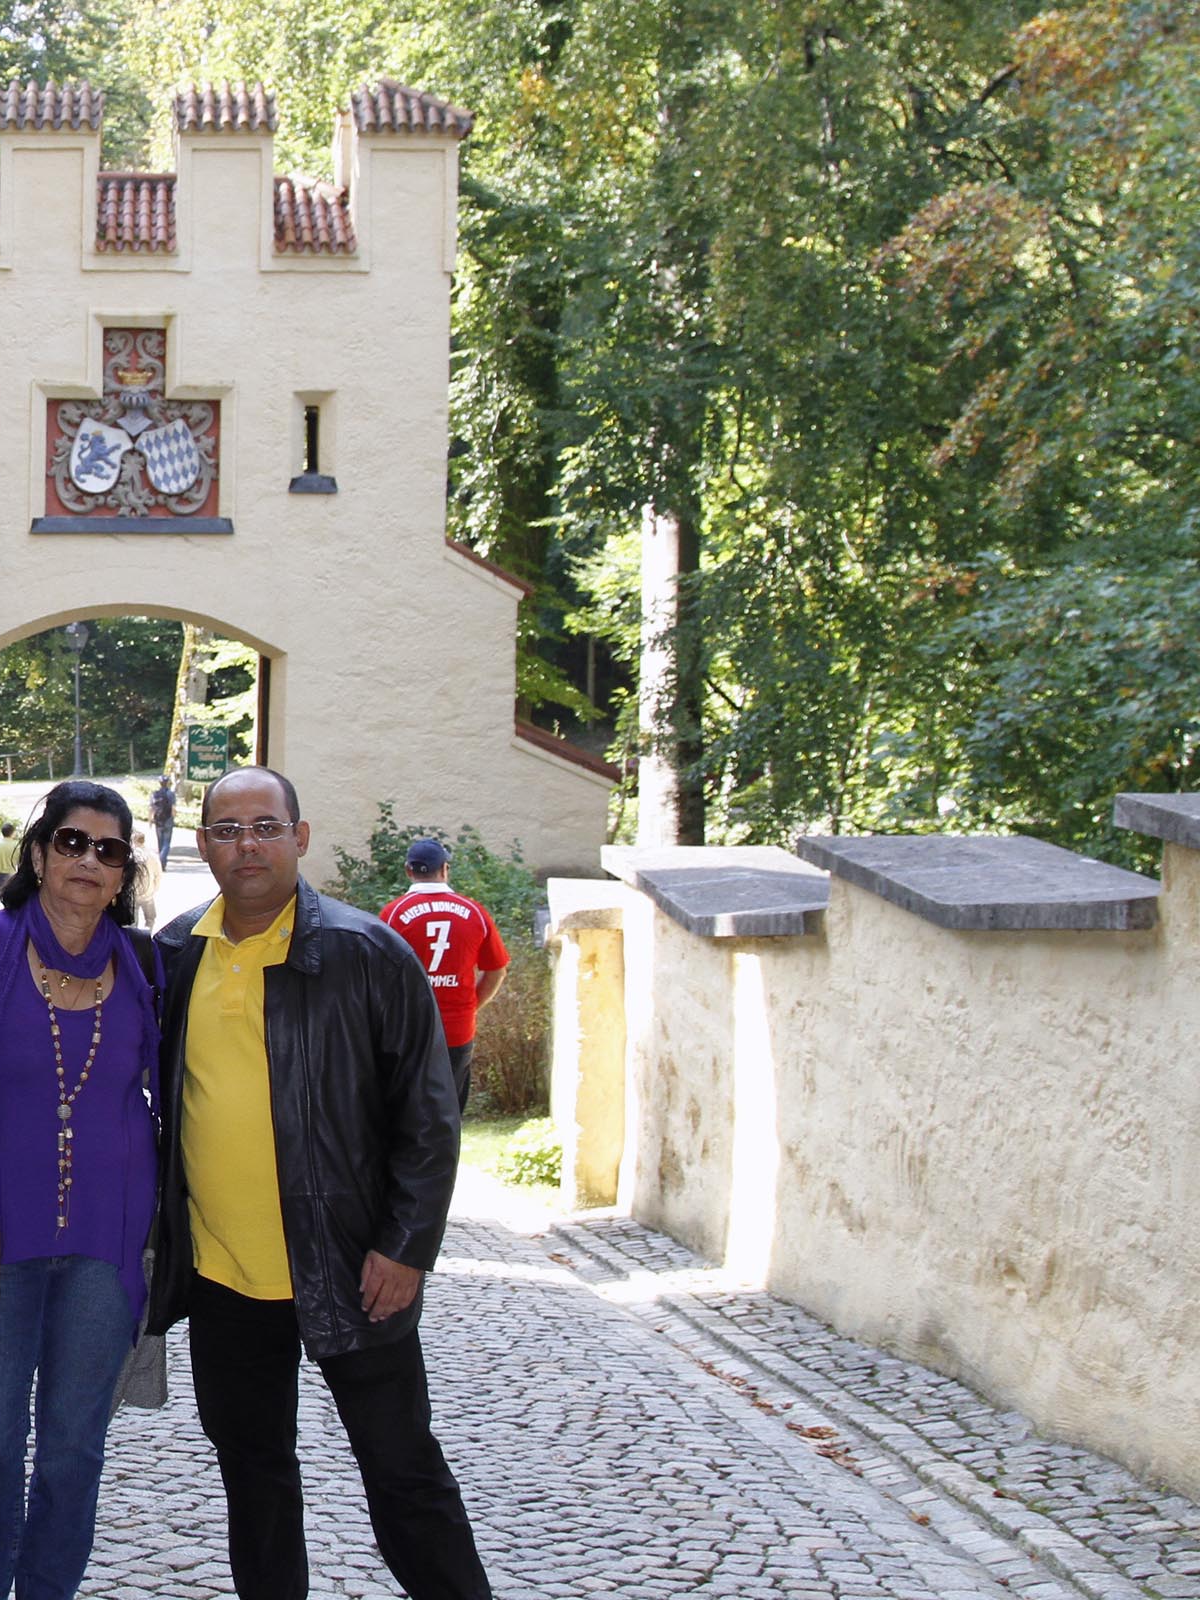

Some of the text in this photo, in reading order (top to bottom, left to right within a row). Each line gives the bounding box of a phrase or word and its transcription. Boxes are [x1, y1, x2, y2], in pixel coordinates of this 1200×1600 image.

[399, 901, 432, 925] BAYERN
[426, 920, 452, 972] 7
[427, 974, 459, 987] MMEL
